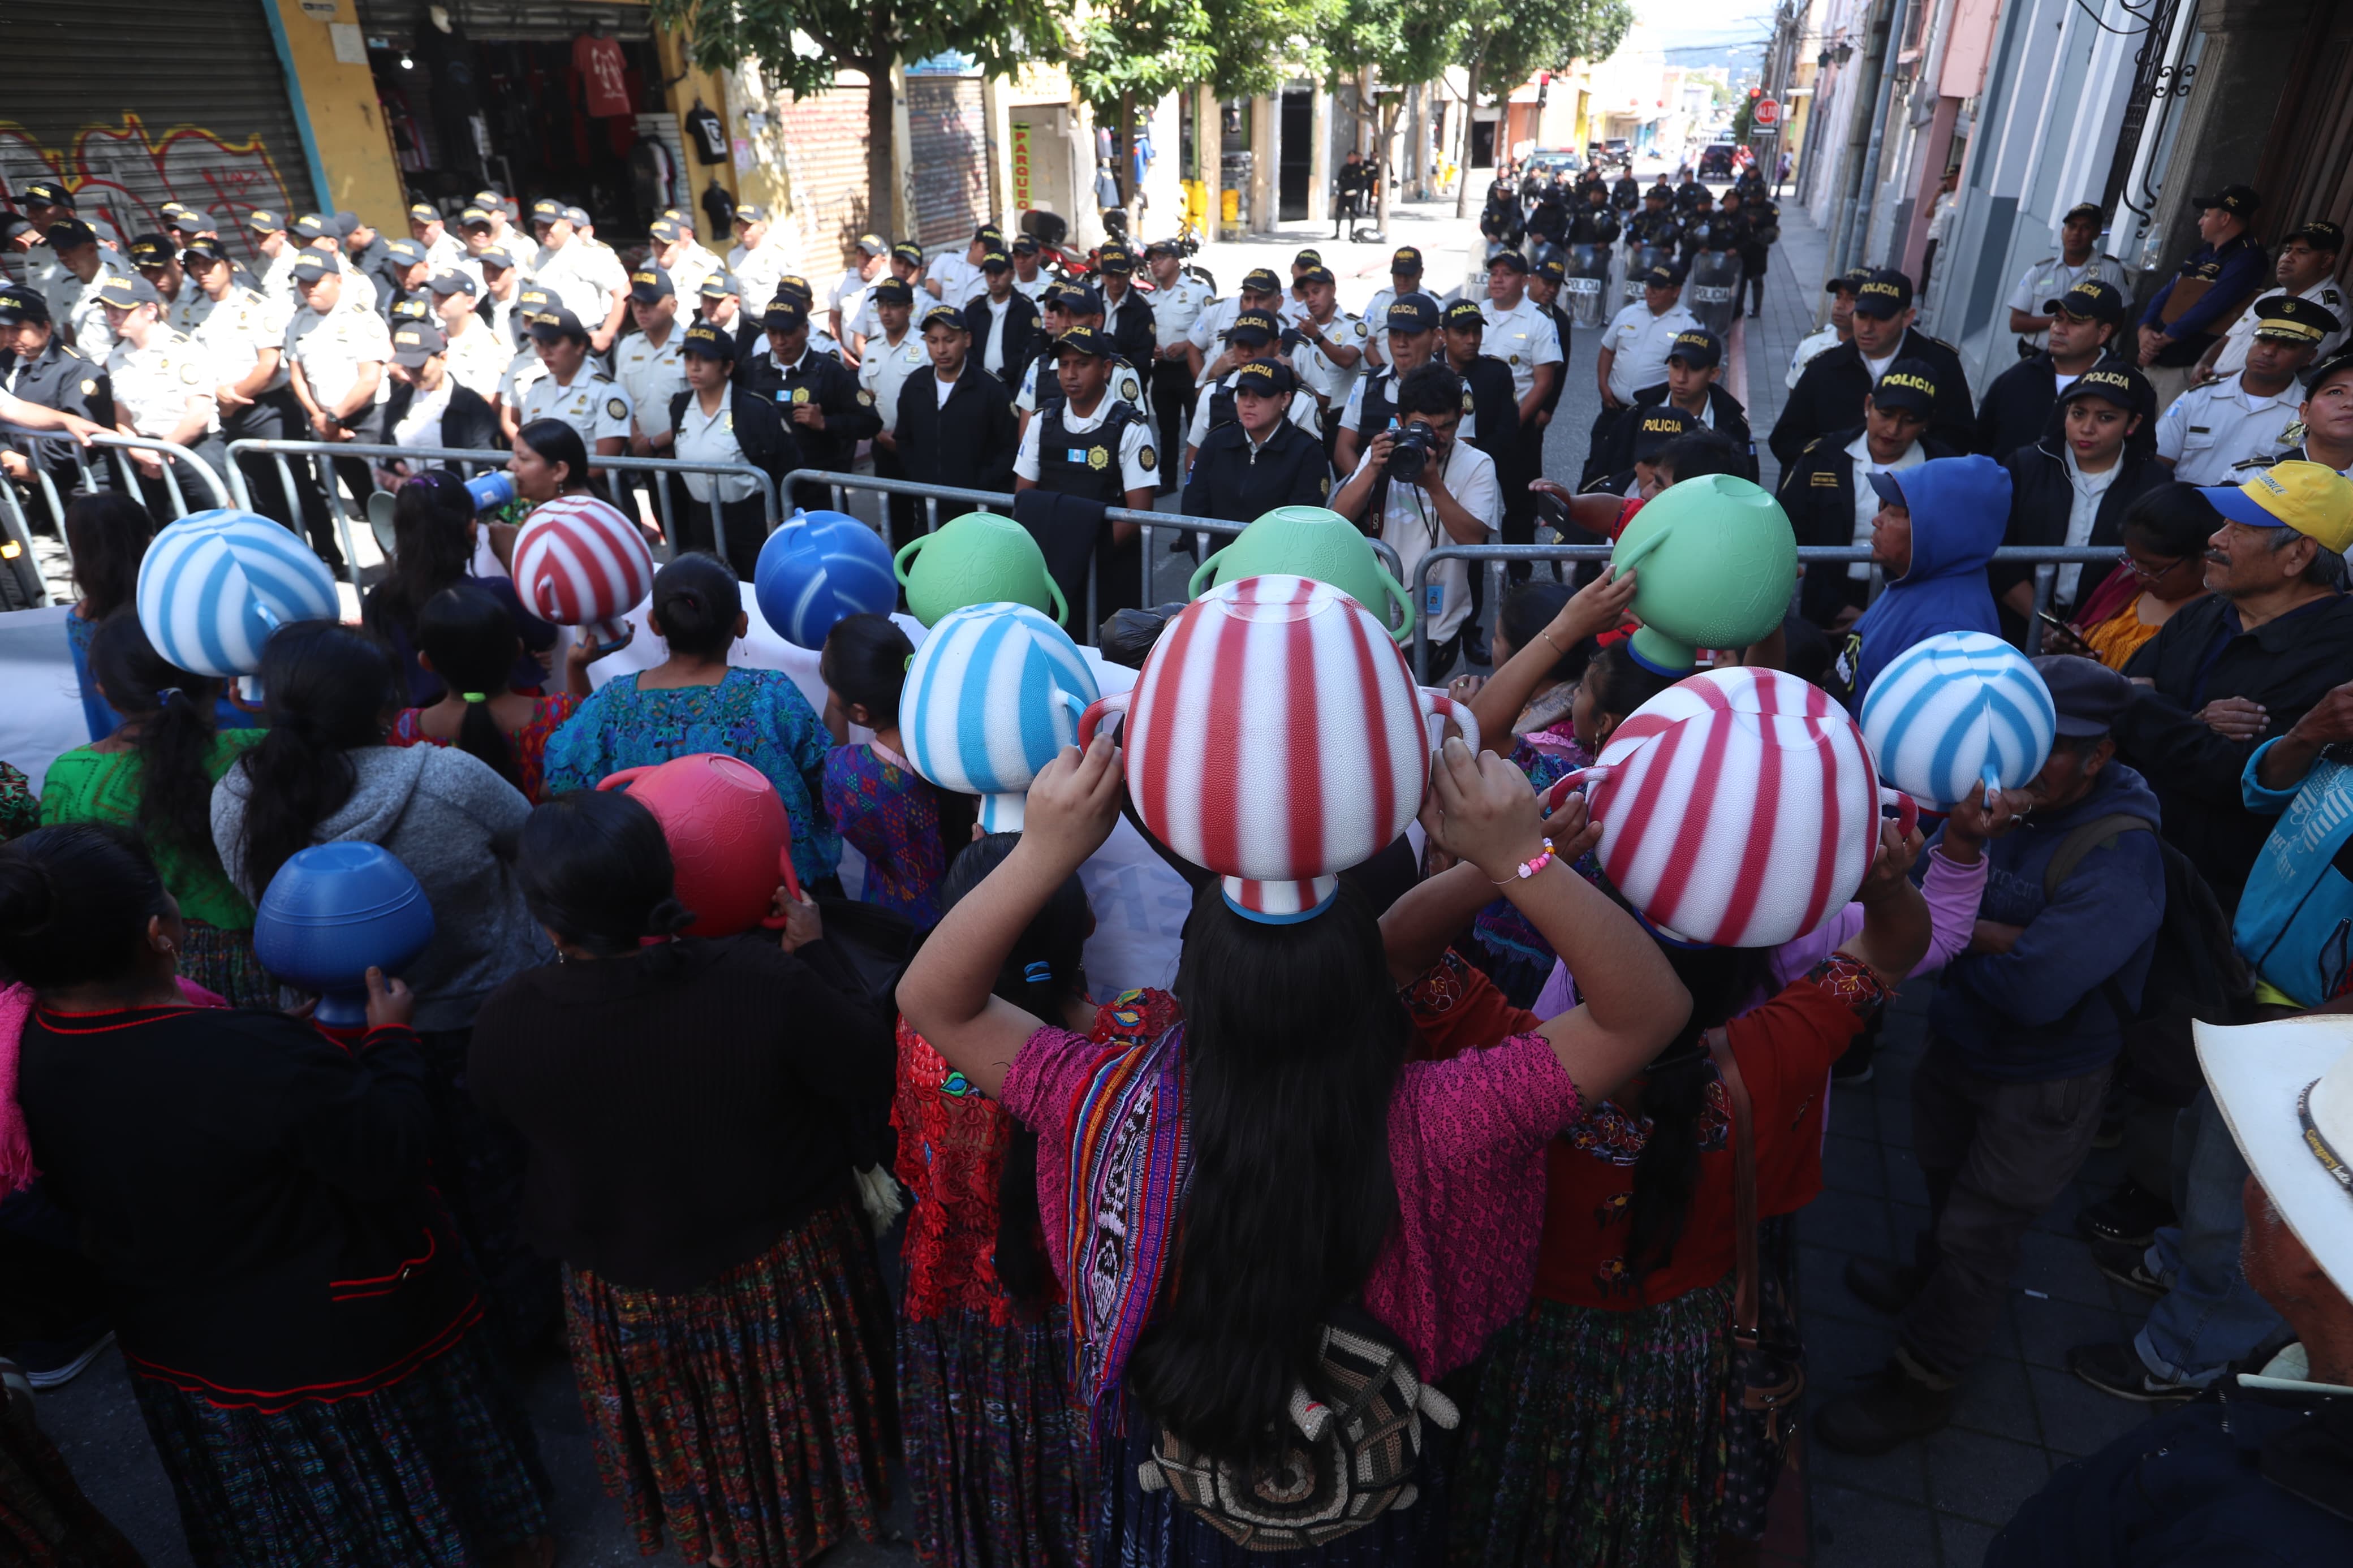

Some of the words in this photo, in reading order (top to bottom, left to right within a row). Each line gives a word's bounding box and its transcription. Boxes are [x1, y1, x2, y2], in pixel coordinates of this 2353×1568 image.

[1756, 105, 1779, 118] ALTO
[1015, 131, 1029, 210] PARQUEO
[1567, 279, 1600, 293] POLICIA
[1860, 282, 1899, 298] POLICIA
[1695, 287, 1729, 301] POLICIA
[1390, 305, 1418, 315] POLICIA
[1234, 317, 1268, 330] POLICIA
[686, 328, 716, 342] POLICIA
[1677, 334, 1708, 348] POLICIA
[1240, 364, 1273, 378] POLICIA
[1882, 374, 1935, 397] POLICIA
[2082, 371, 2129, 390] POLICIA
[1643, 418, 1682, 433] POLICIA
